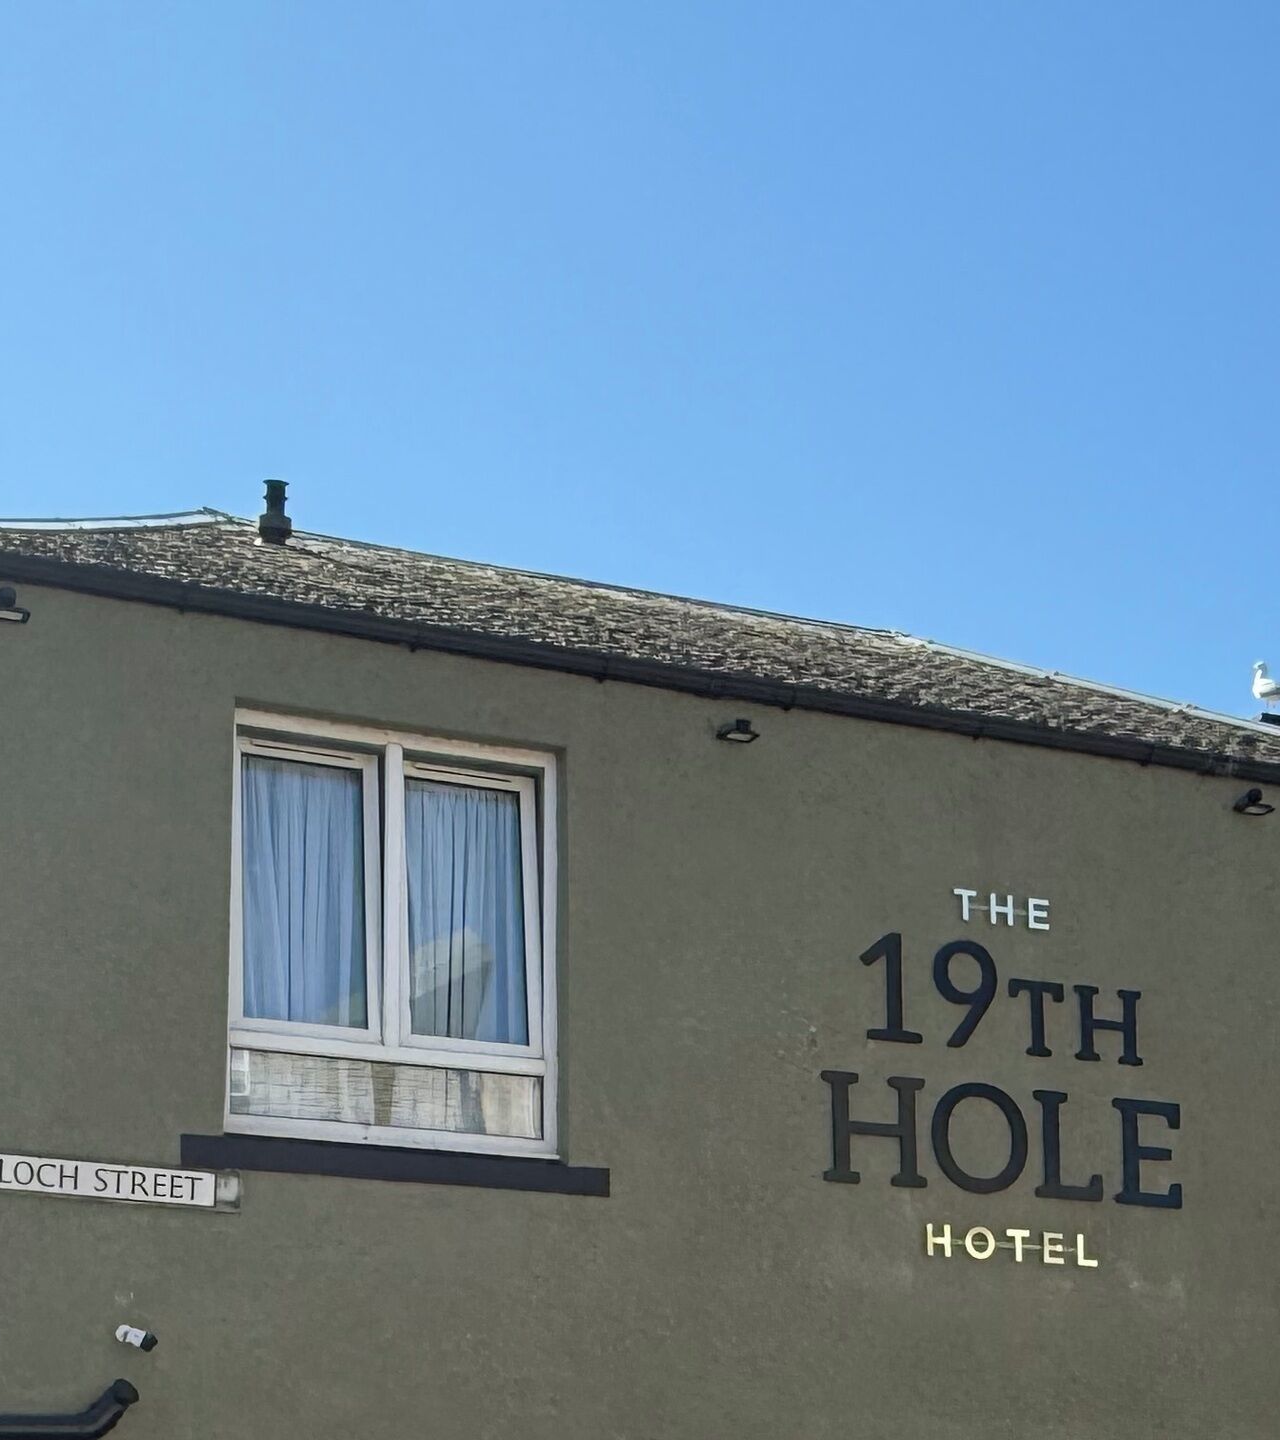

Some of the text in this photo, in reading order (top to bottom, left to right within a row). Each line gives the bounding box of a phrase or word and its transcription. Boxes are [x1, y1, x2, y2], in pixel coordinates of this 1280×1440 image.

[953, 887, 1051, 931] THE
[858, 931, 1144, 1067] 19TH
[819, 1069, 1184, 1210] HOLE
[93, 1167, 204, 1201] STREET
[925, 1222, 1099, 1268] HOTEL
